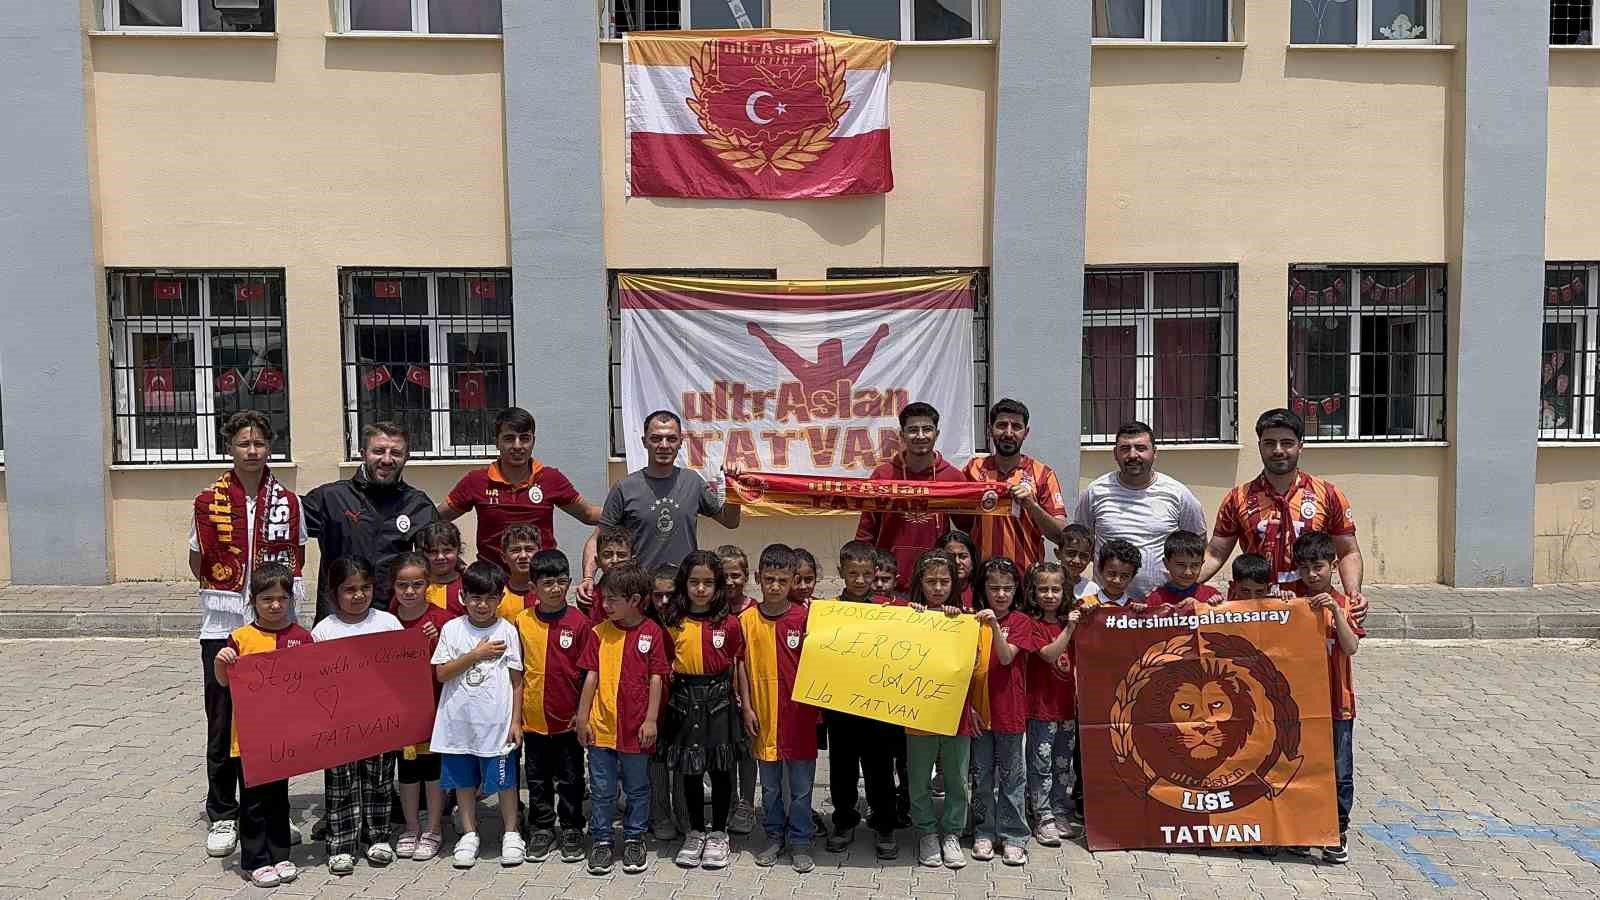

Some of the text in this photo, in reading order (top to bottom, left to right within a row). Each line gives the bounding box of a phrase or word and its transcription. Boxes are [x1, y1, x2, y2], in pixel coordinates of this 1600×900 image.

[682, 379, 911, 423] ultrAslan
[1105, 608, 1291, 630] #dersimizgalatasaray
[850, 693, 920, 721] TATVAN
[312, 713, 400, 750] TATVAN
[1160, 824, 1262, 844] TATVAN
